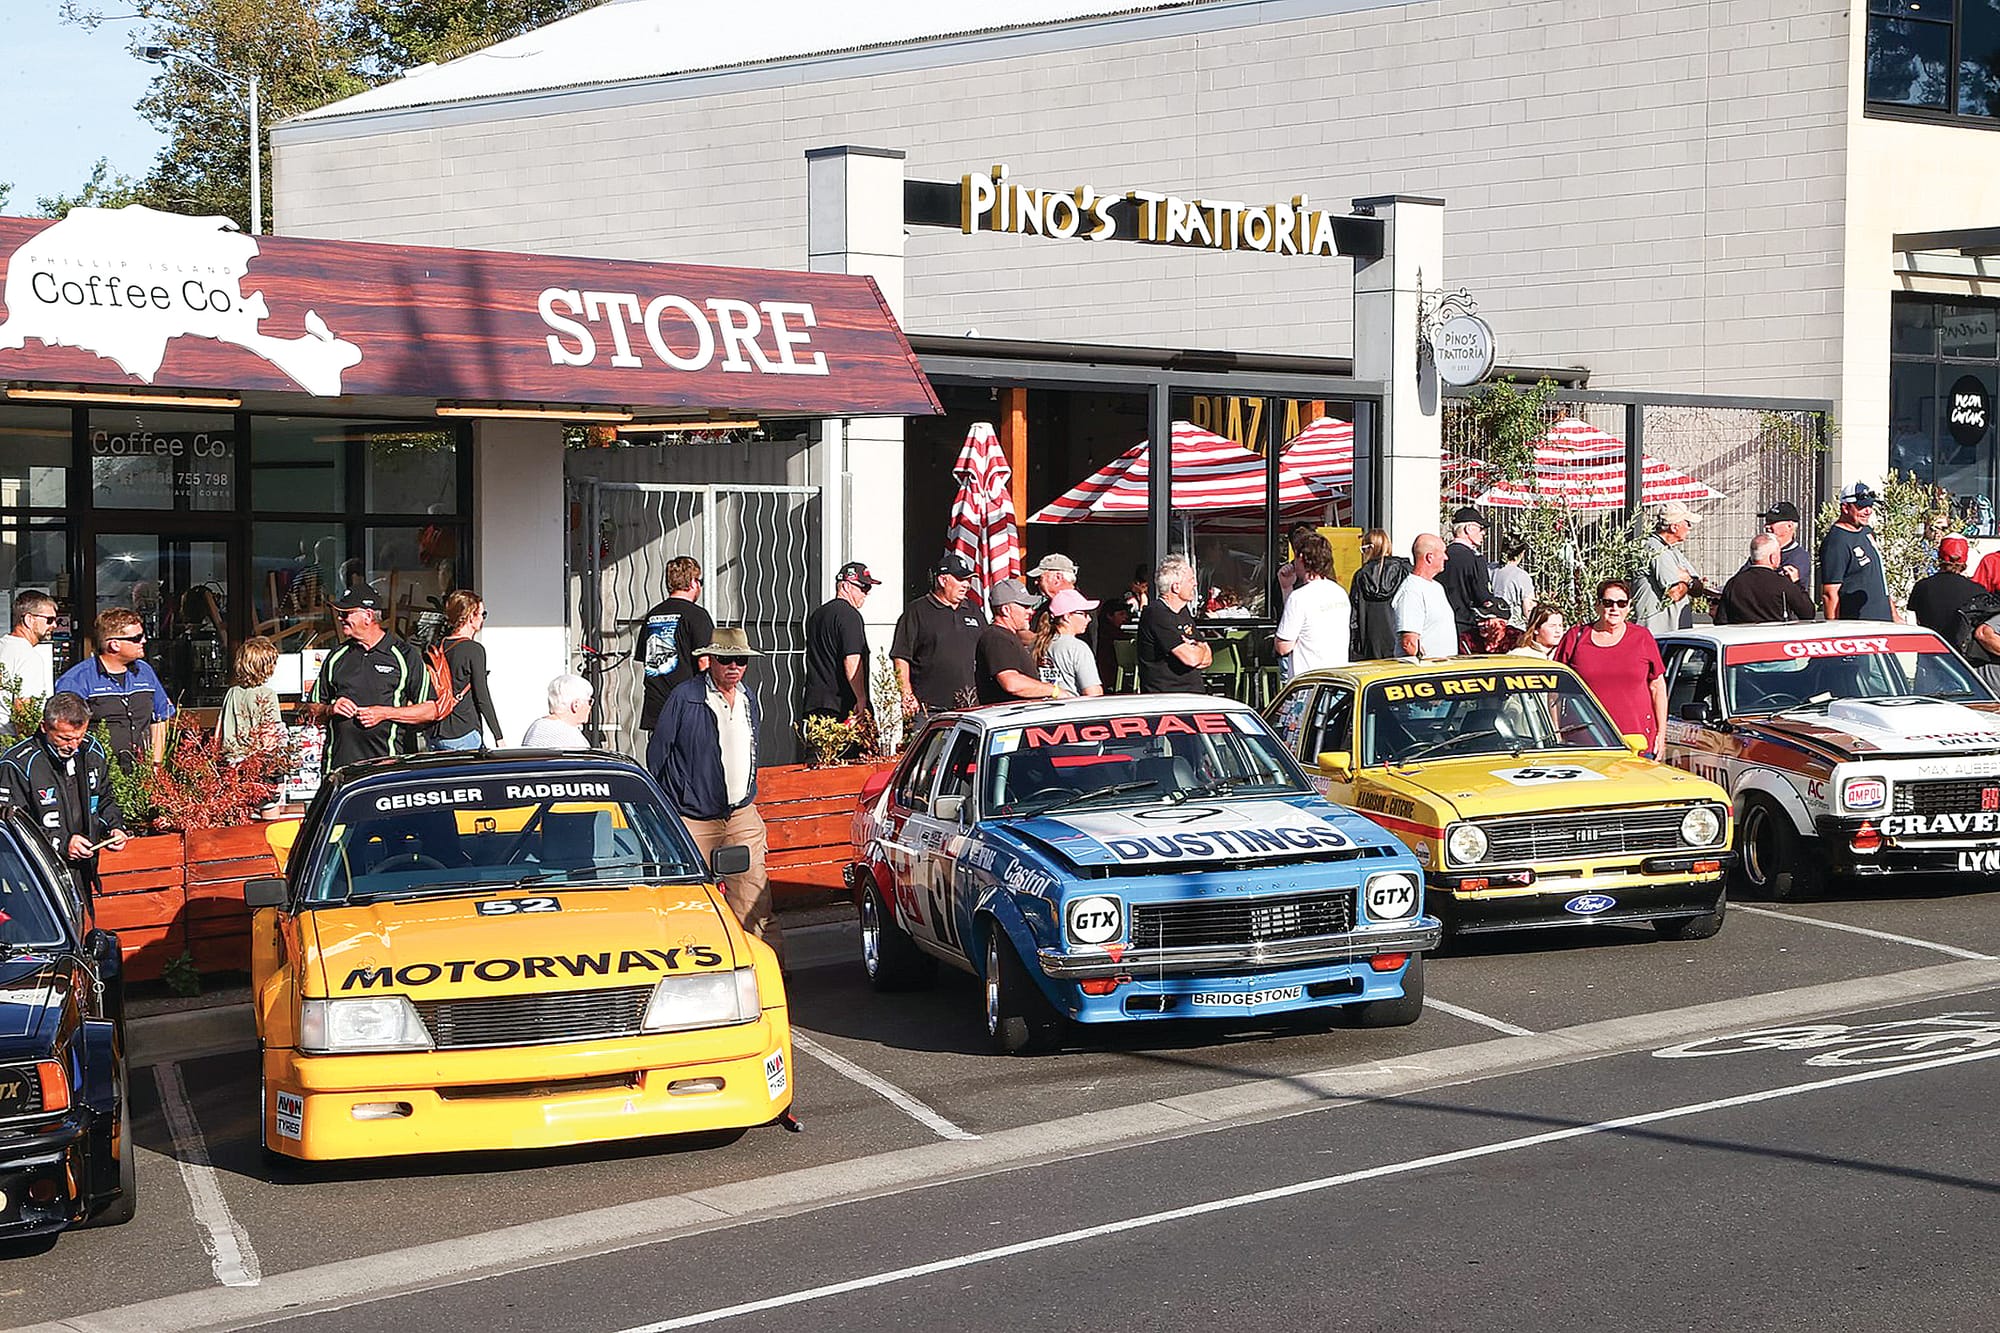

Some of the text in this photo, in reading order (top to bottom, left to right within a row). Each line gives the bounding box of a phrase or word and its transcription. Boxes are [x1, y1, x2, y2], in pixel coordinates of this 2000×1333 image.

[962, 163, 1338, 256] PINO'S TRATTORIA
[32, 271, 243, 313] Coffee Co.
[537, 287, 830, 376] STORE
[1445, 331, 1477, 346] PINO'S
[1438, 345, 1484, 360] TRATTORIA
[1955, 393, 1981, 408] neon
[1192, 395, 1299, 457] PIAZA
[93, 430, 184, 456] Coffee
[177, 472, 201, 486] 755
[205, 473, 228, 486] 798
[1783, 638, 1890, 657] GRICEY
[1384, 675, 1559, 701] BIG REV NEV
[1025, 713, 1233, 748] McRAE
[1513, 768, 1582, 779] 53
[1918, 764, 1949, 777] MAX
[375, 782, 611, 811] GEISSLER RADBURN
[1807, 779, 1825, 800] AC
[1848, 788, 1881, 803] AMPOL
[1880, 813, 2000, 836] CRAVE
[1104, 826, 1347, 860] DUSTINGS
[1004, 859, 1051, 899] Castrol
[478, 898, 557, 916] 52
[1372, 887, 1411, 906] GTX
[1075, 910, 1116, 931] GTX
[1193, 986, 1301, 1005] BRIDGESTONE
[278, 1096, 302, 1115] AVON
